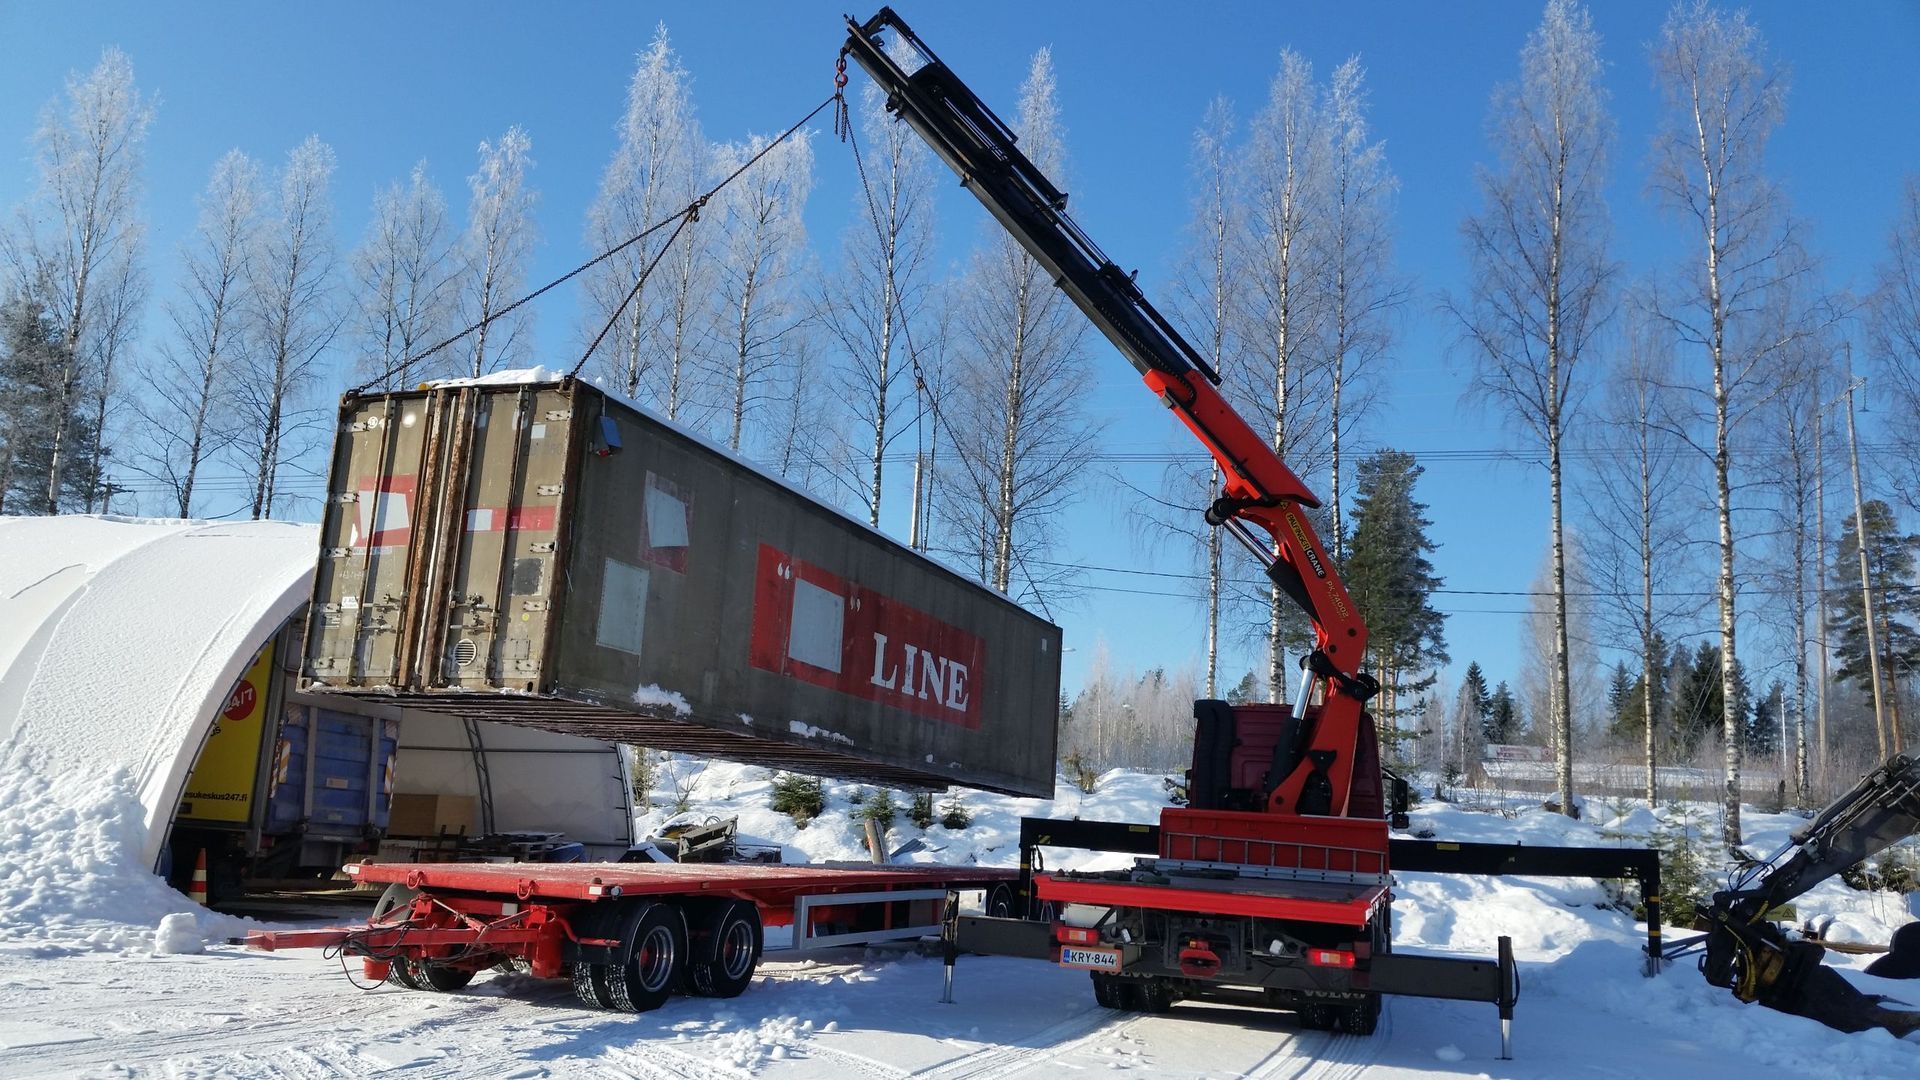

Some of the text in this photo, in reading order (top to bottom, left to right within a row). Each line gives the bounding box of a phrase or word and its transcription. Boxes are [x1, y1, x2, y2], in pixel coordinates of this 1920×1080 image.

[1287, 513, 1325, 577] PALFINGER CRANE
[870, 631, 970, 712] LINE
[1071, 951, 1115, 966] KRY-844
